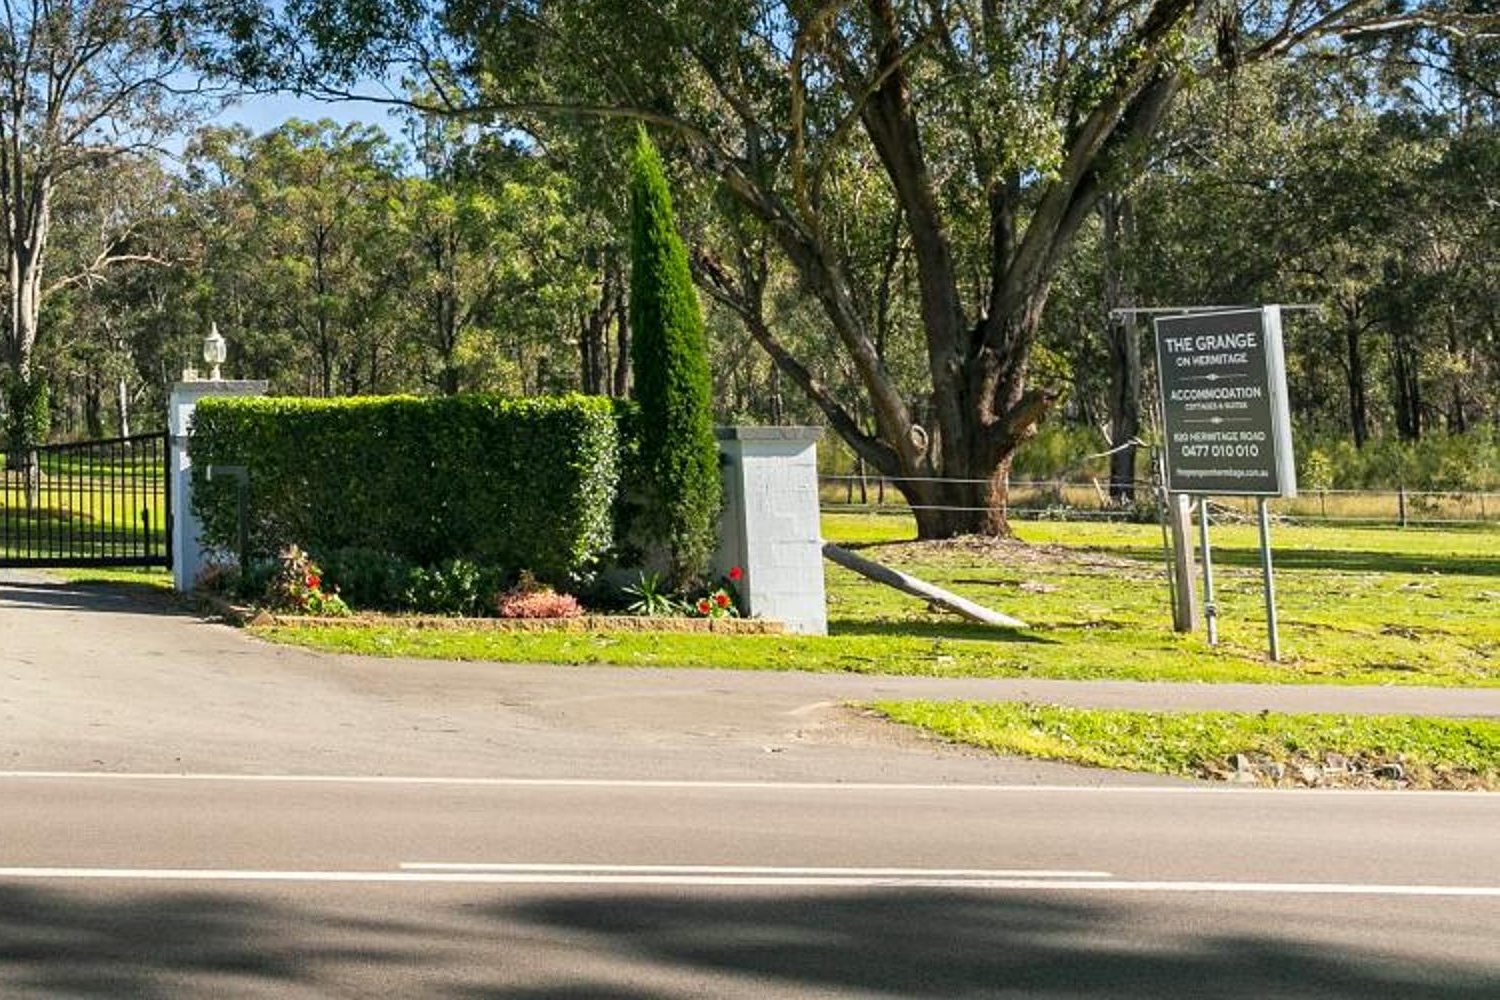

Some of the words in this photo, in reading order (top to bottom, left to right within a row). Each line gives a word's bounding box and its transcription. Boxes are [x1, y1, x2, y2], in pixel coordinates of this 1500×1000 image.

[1164, 337, 1193, 353] THE
[1195, 332, 1258, 351] GRANGE
[1176, 356, 1191, 367] ON
[1192, 352, 1249, 366] HERMITAGE
[1171, 386, 1261, 400] ACCOMMODATION
[1190, 431, 1239, 442] HERMITAGE
[1240, 431, 1266, 441] ROAD
[1181, 444, 1209, 457] 0477
[1211, 444, 1234, 457] 010
[1235, 443, 1259, 457] 010
[1176, 468, 1269, 479] gghrmitage.com.au
